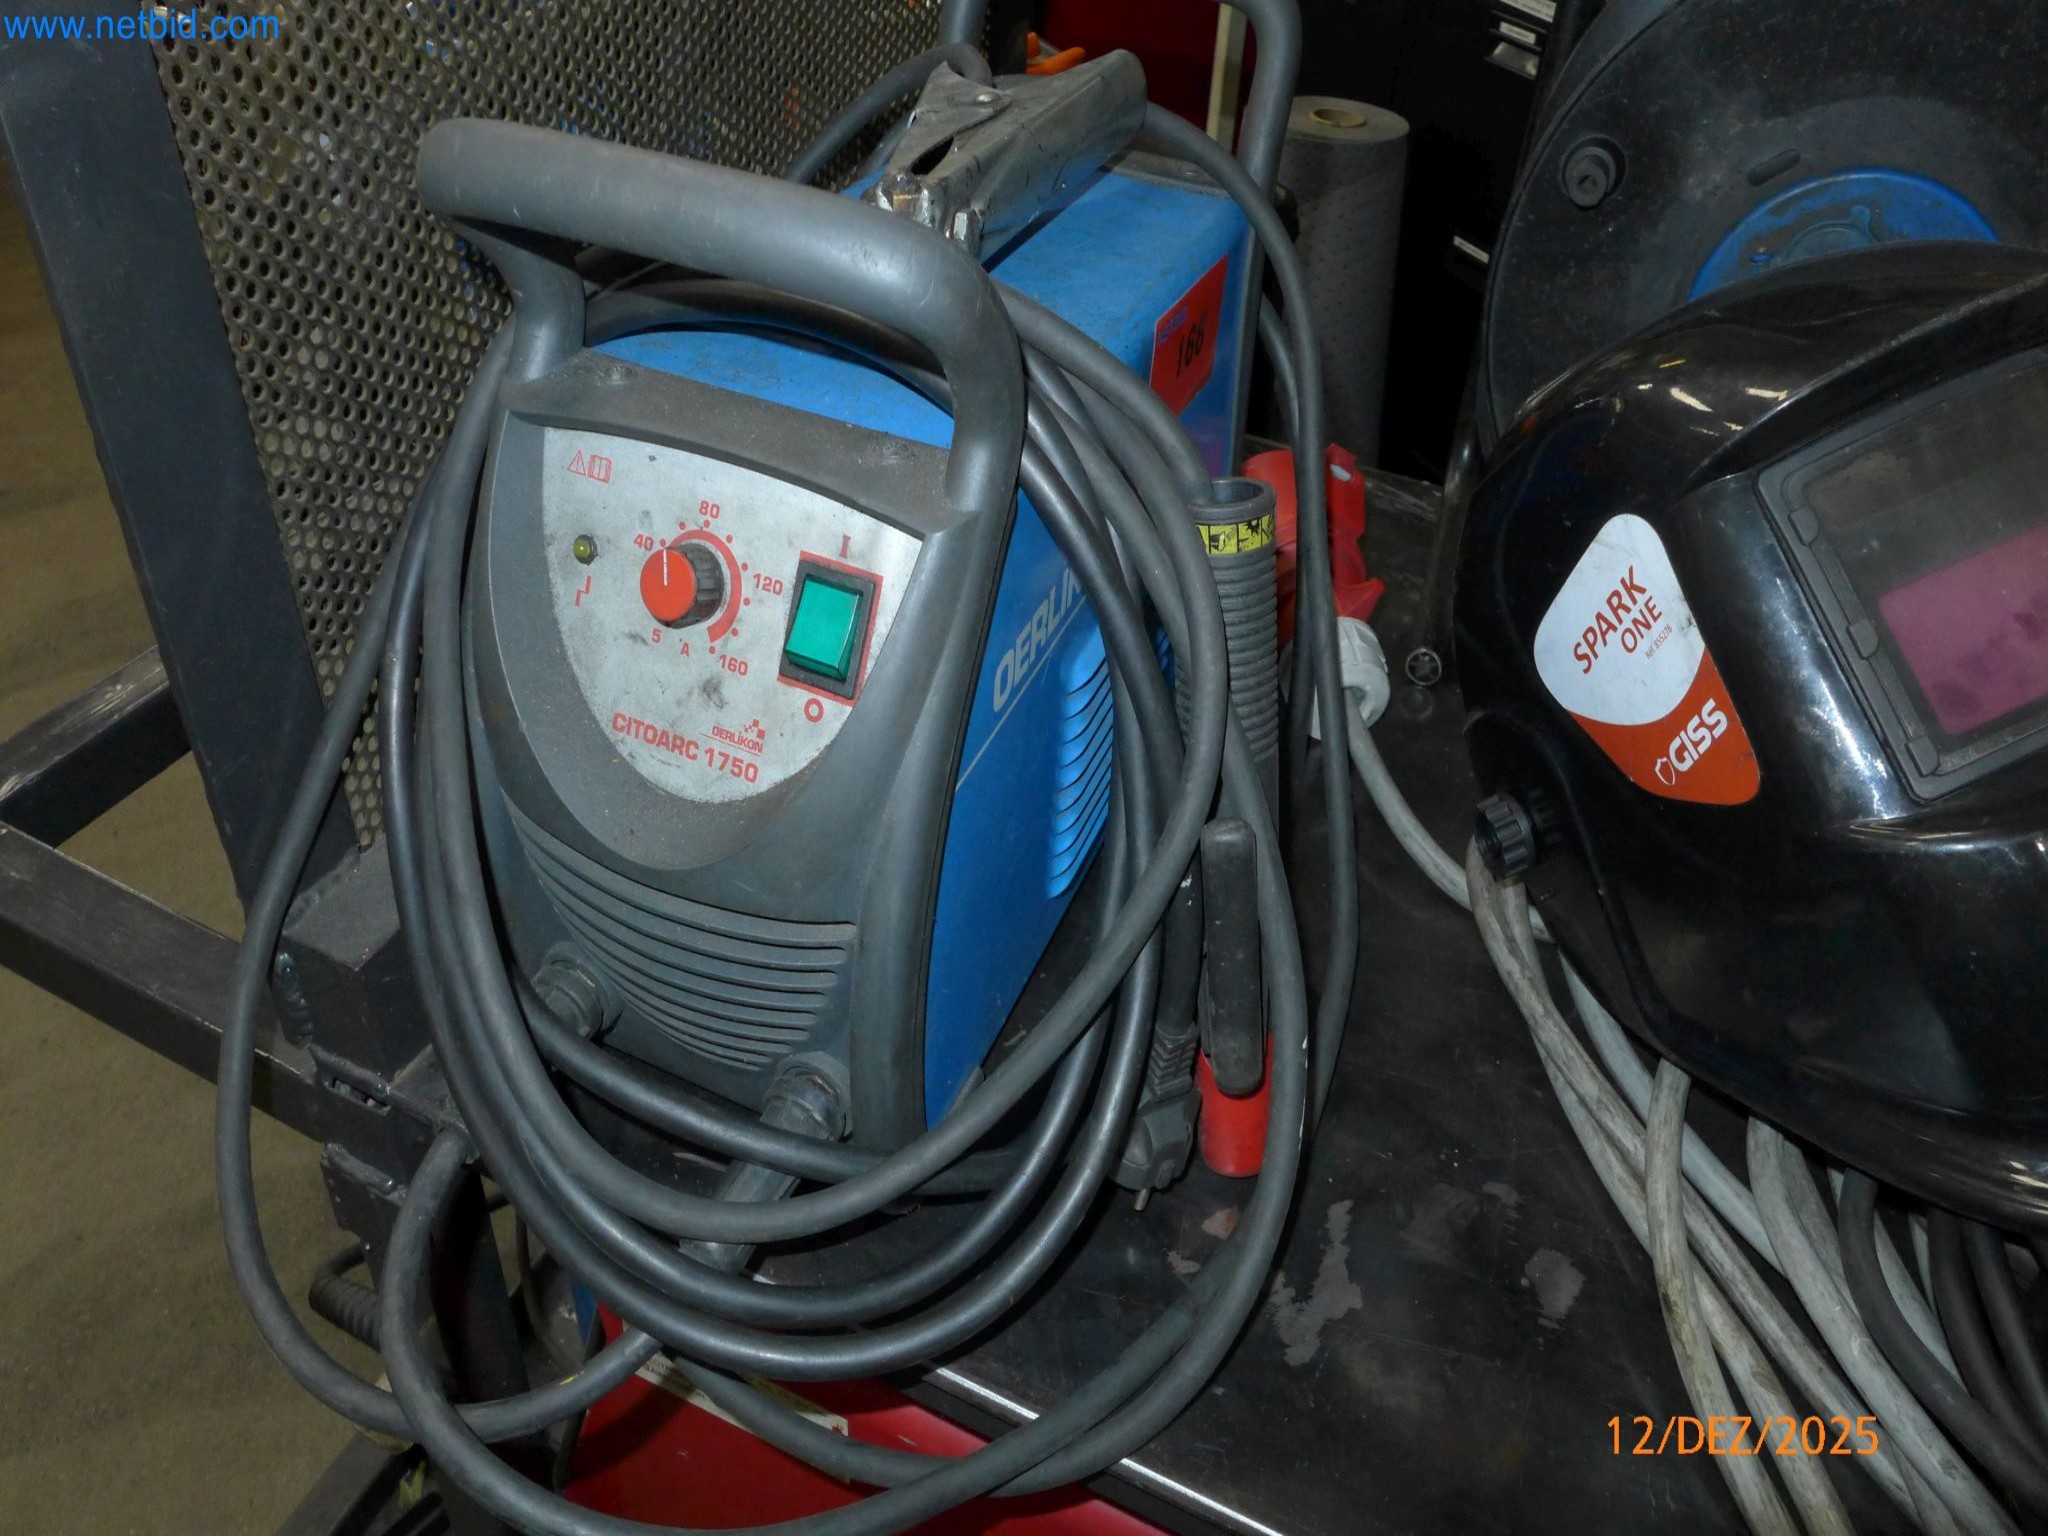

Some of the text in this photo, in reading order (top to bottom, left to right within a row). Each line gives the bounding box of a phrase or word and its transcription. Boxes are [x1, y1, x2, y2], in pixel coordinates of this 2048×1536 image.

[699, 501, 720, 520] 80
[634, 533, 654, 552] 40
[752, 572, 784, 597] 120
[1573, 564, 1648, 675] SPARK
[1620, 596, 1663, 654] ONE
[651, 628, 662, 644] 5
[680, 643, 690, 657] A
[719, 654, 749, 677] 160
[1668, 698, 1728, 773] GISS
[612, 712, 760, 784] CITOARC 1750
